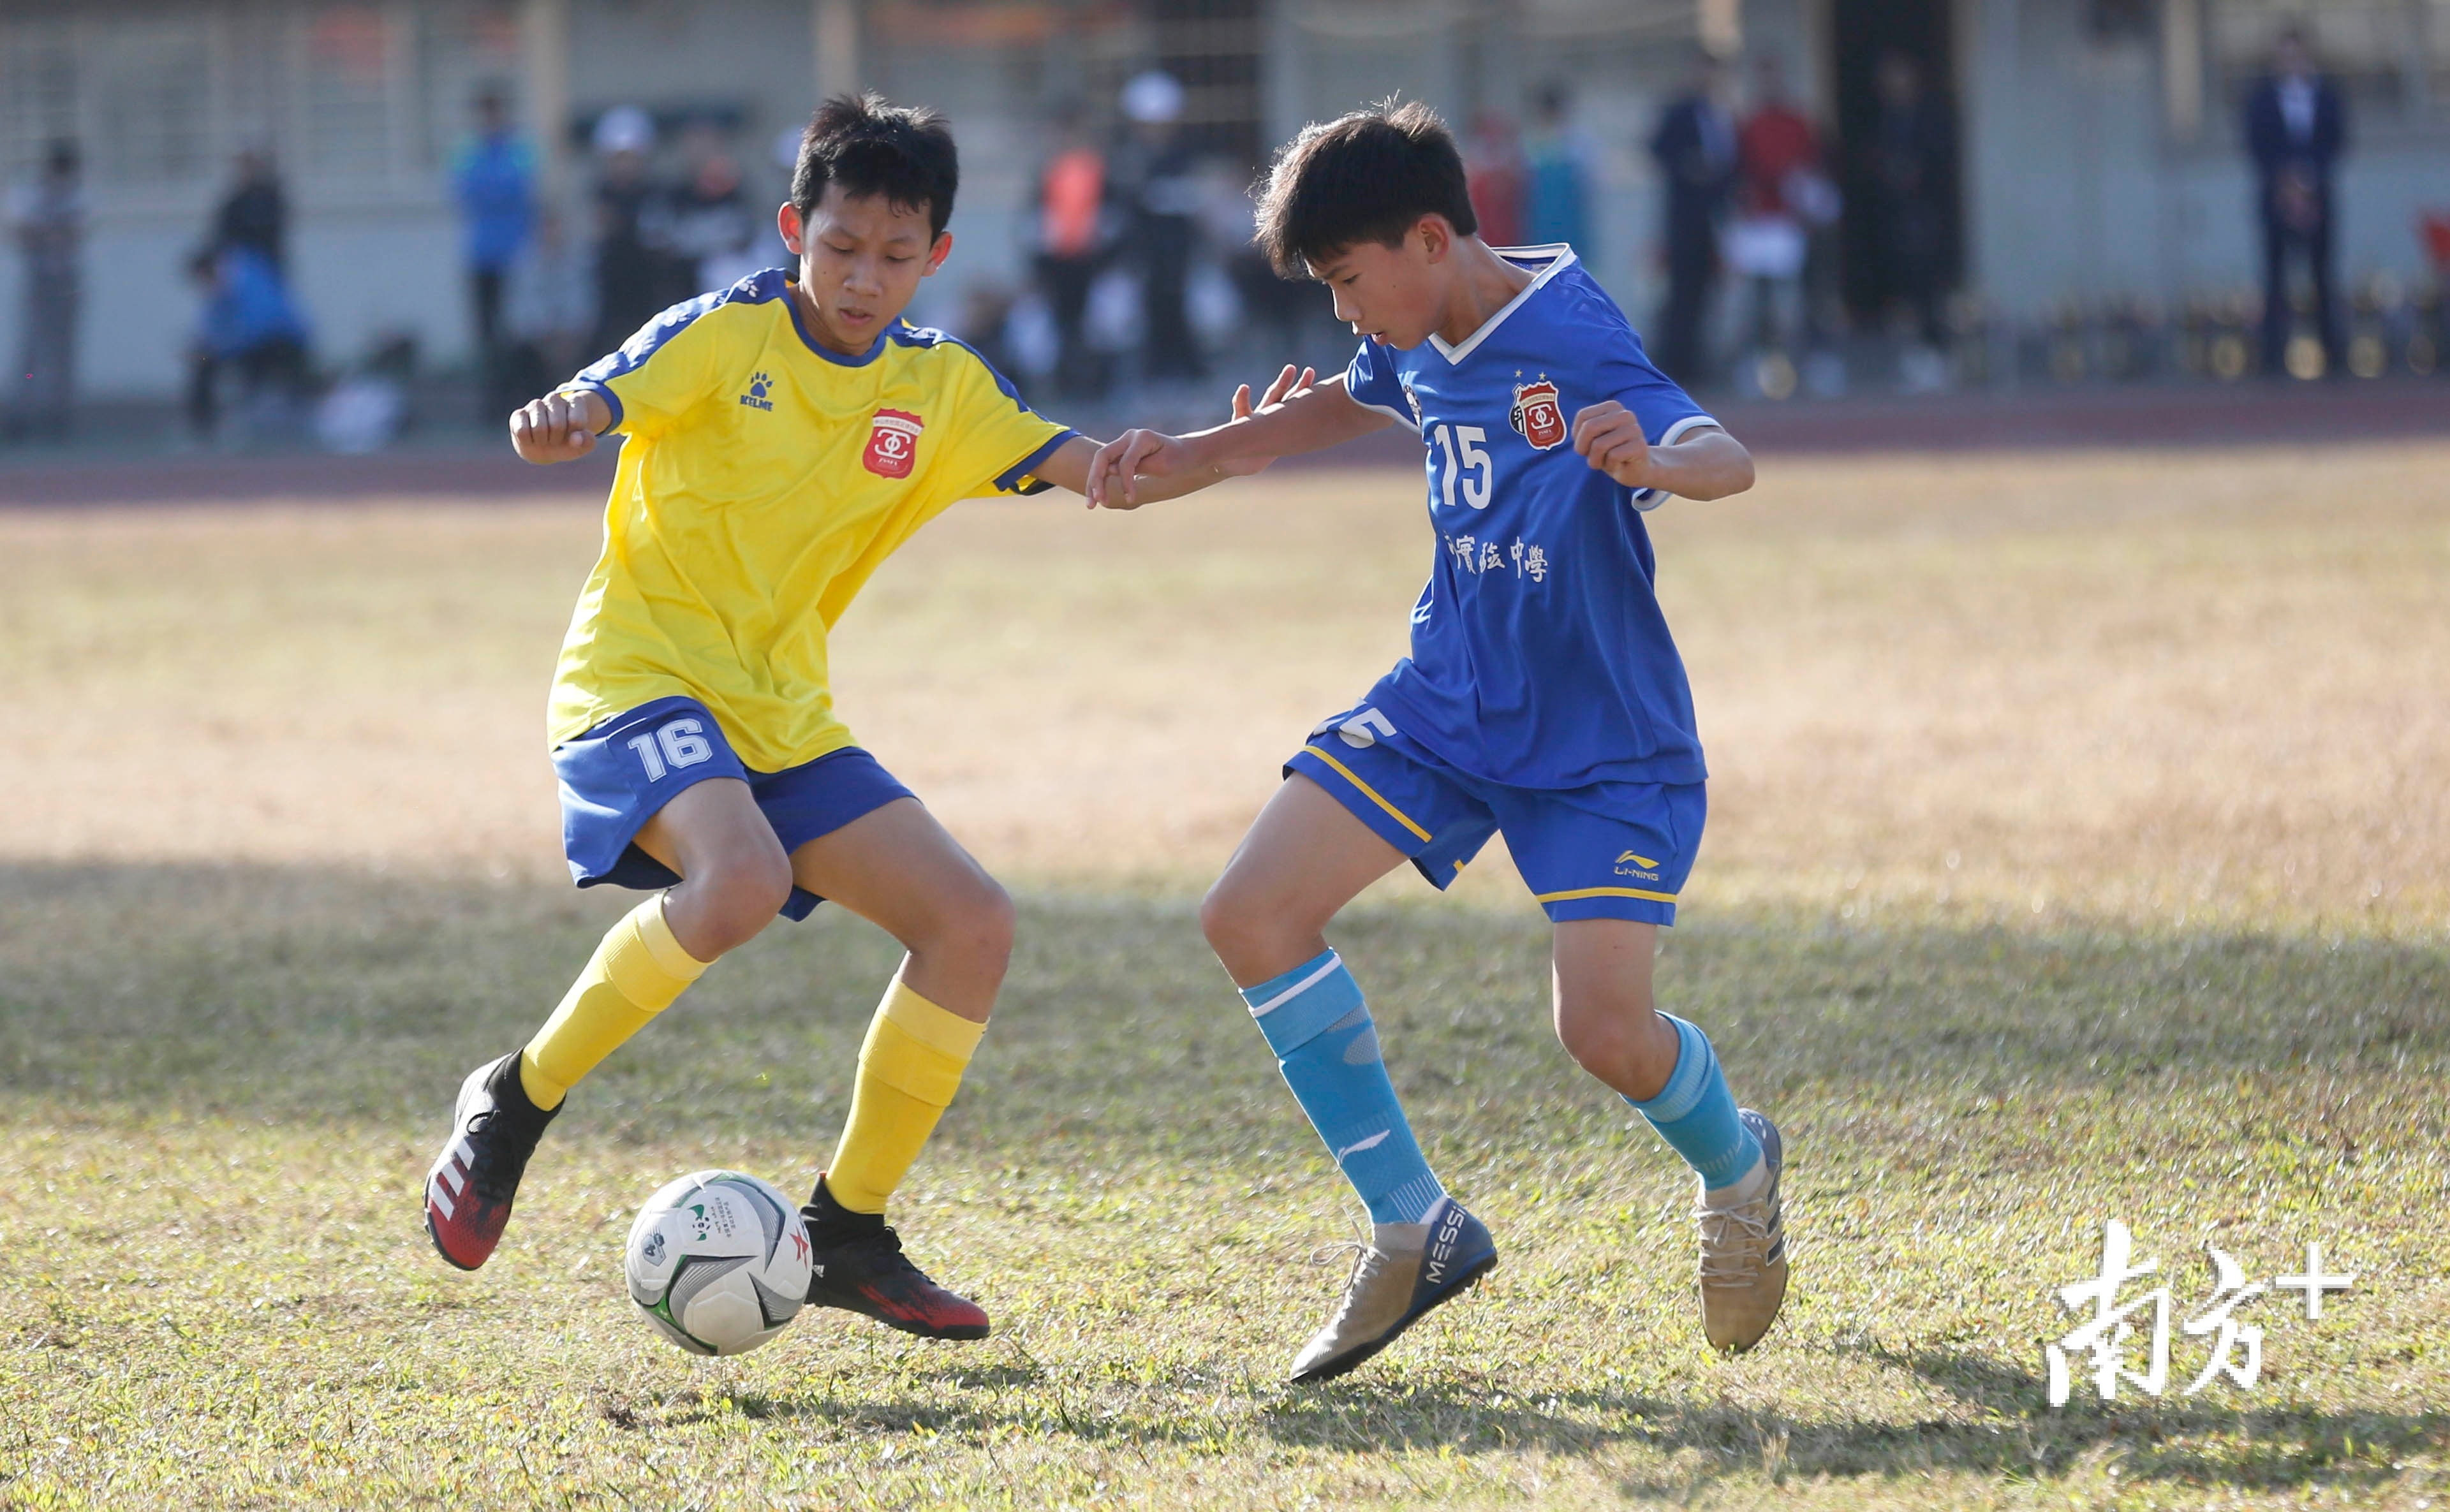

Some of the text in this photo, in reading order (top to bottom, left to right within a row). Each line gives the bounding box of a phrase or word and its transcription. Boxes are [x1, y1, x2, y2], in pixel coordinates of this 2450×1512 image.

[740, 395, 773, 411] KELME
[1434, 425, 1492, 510] 15
[628, 718, 713, 783] 16
[1614, 867, 1659, 881] LI-NING
